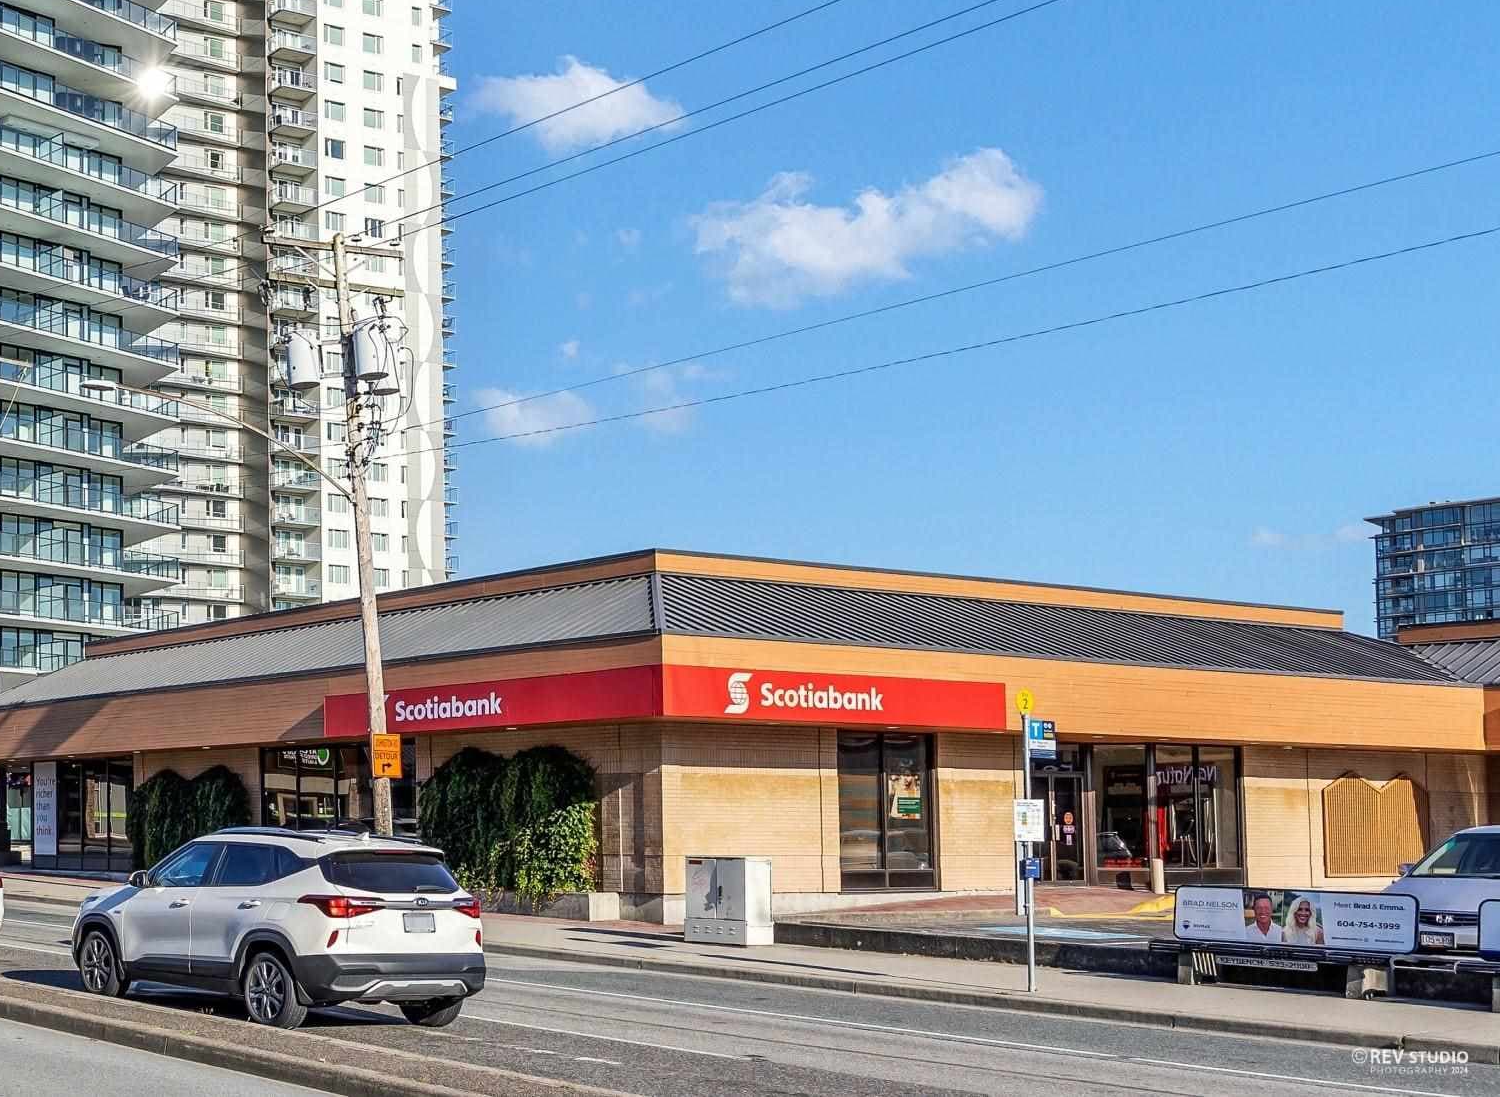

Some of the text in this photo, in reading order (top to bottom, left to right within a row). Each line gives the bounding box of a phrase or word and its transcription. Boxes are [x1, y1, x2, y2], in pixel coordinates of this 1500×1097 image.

[760, 682, 884, 711] Scotiabank
[395, 691, 502, 722] Scotiabank
[1022, 697, 1029, 710] 2
[36, 788, 53, 799] richer
[36, 801, 51, 811] than
[36, 813, 48, 825] you
[1353, 902, 1371, 910] Brad
[1336, 920, 1401, 930] 604-754-3999
